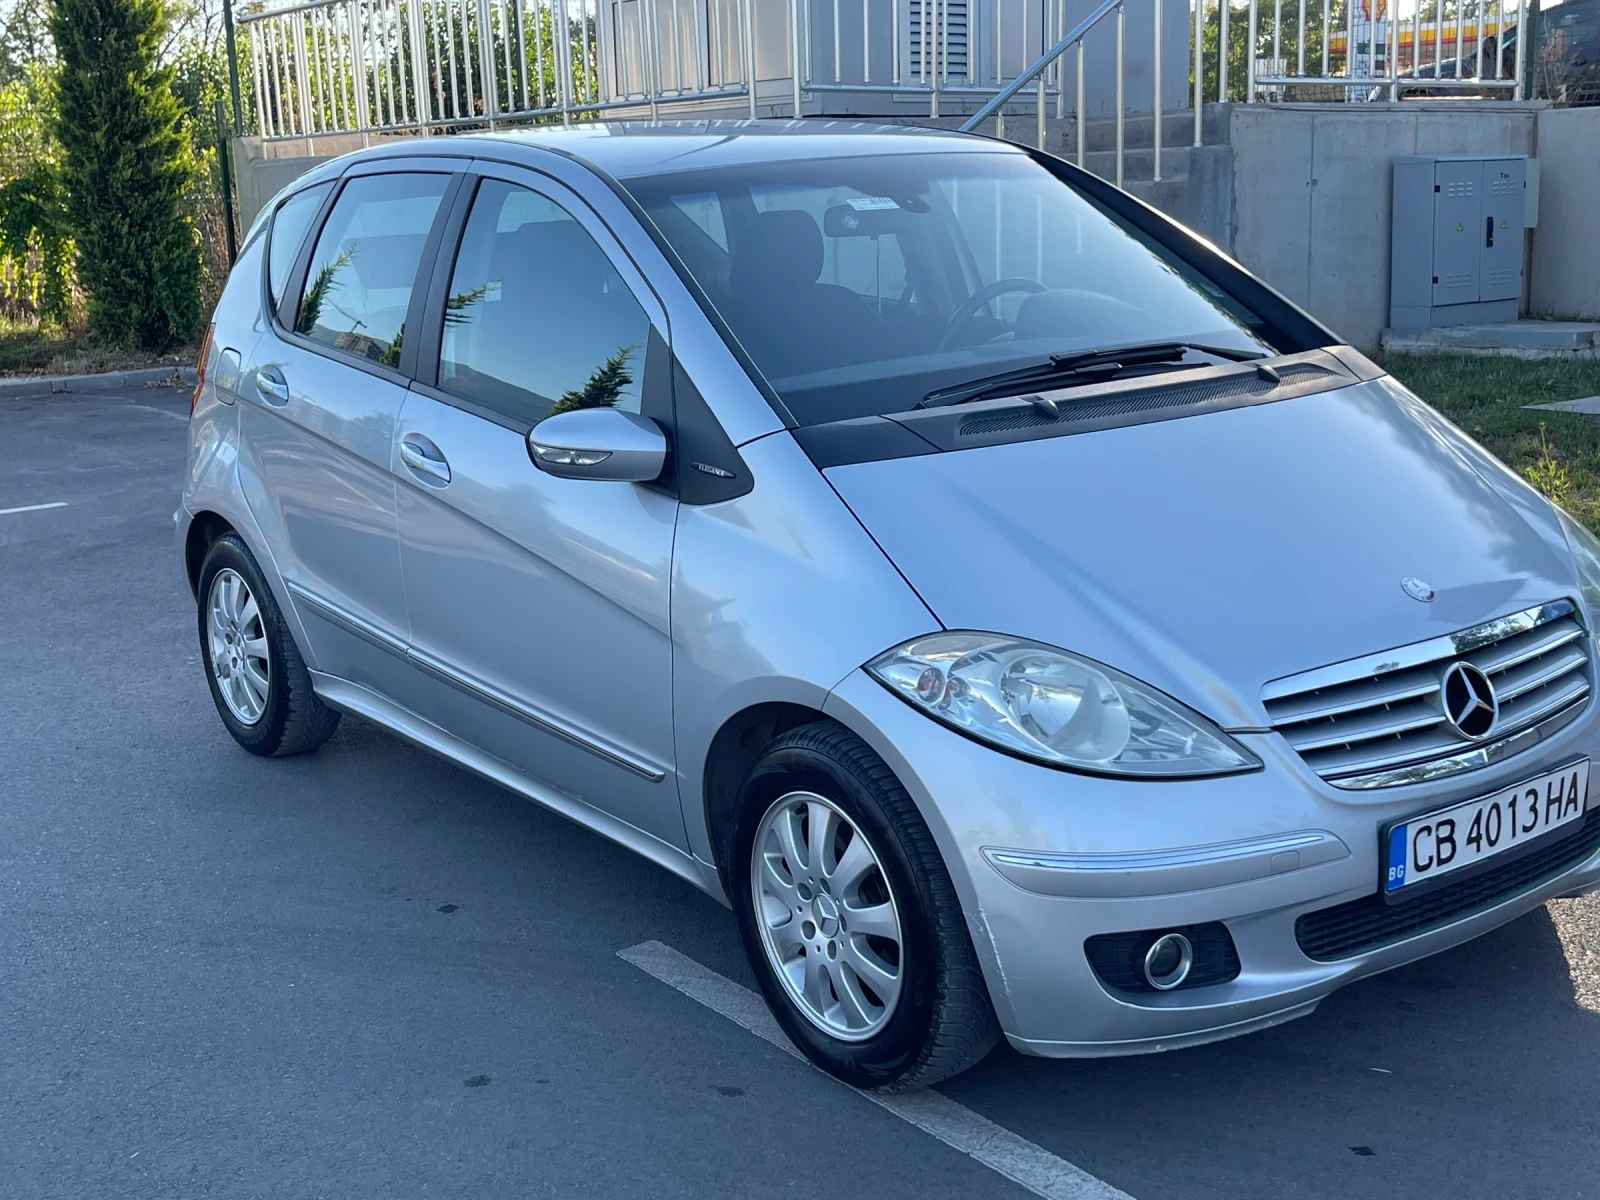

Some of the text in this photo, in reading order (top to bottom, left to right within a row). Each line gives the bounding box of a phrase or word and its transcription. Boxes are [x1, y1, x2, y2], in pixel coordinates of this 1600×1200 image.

[698, 463, 725, 477] ELEGANCE
[1413, 771, 1578, 873] CB 4013 HA
[1388, 864, 1405, 881] BG
